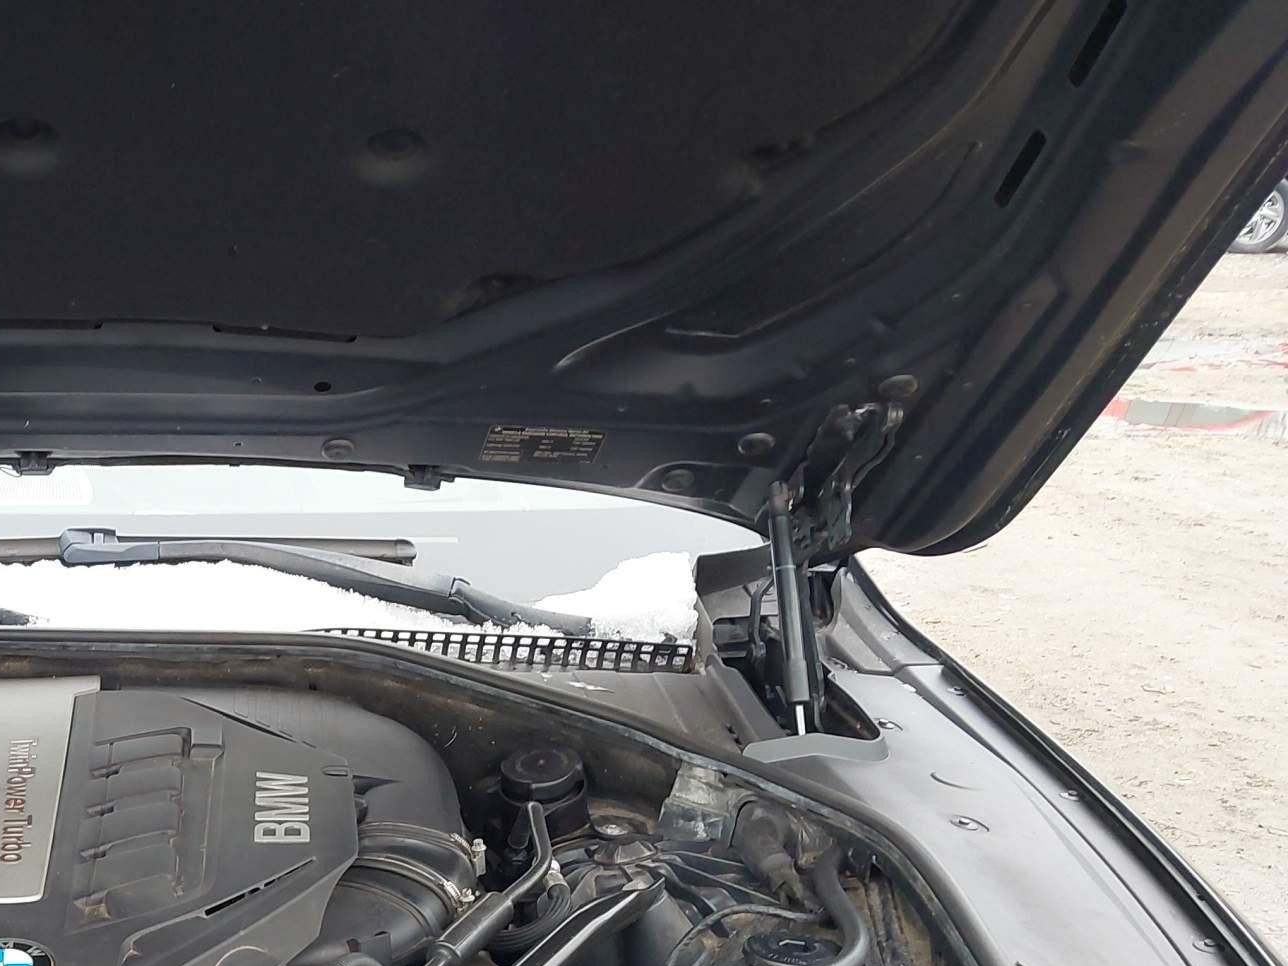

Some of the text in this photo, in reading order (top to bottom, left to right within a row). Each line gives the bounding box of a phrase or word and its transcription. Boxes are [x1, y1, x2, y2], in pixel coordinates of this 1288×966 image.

[0, 736, 39, 864] TwinPower Turbo
[254, 771, 311, 843] BMW
